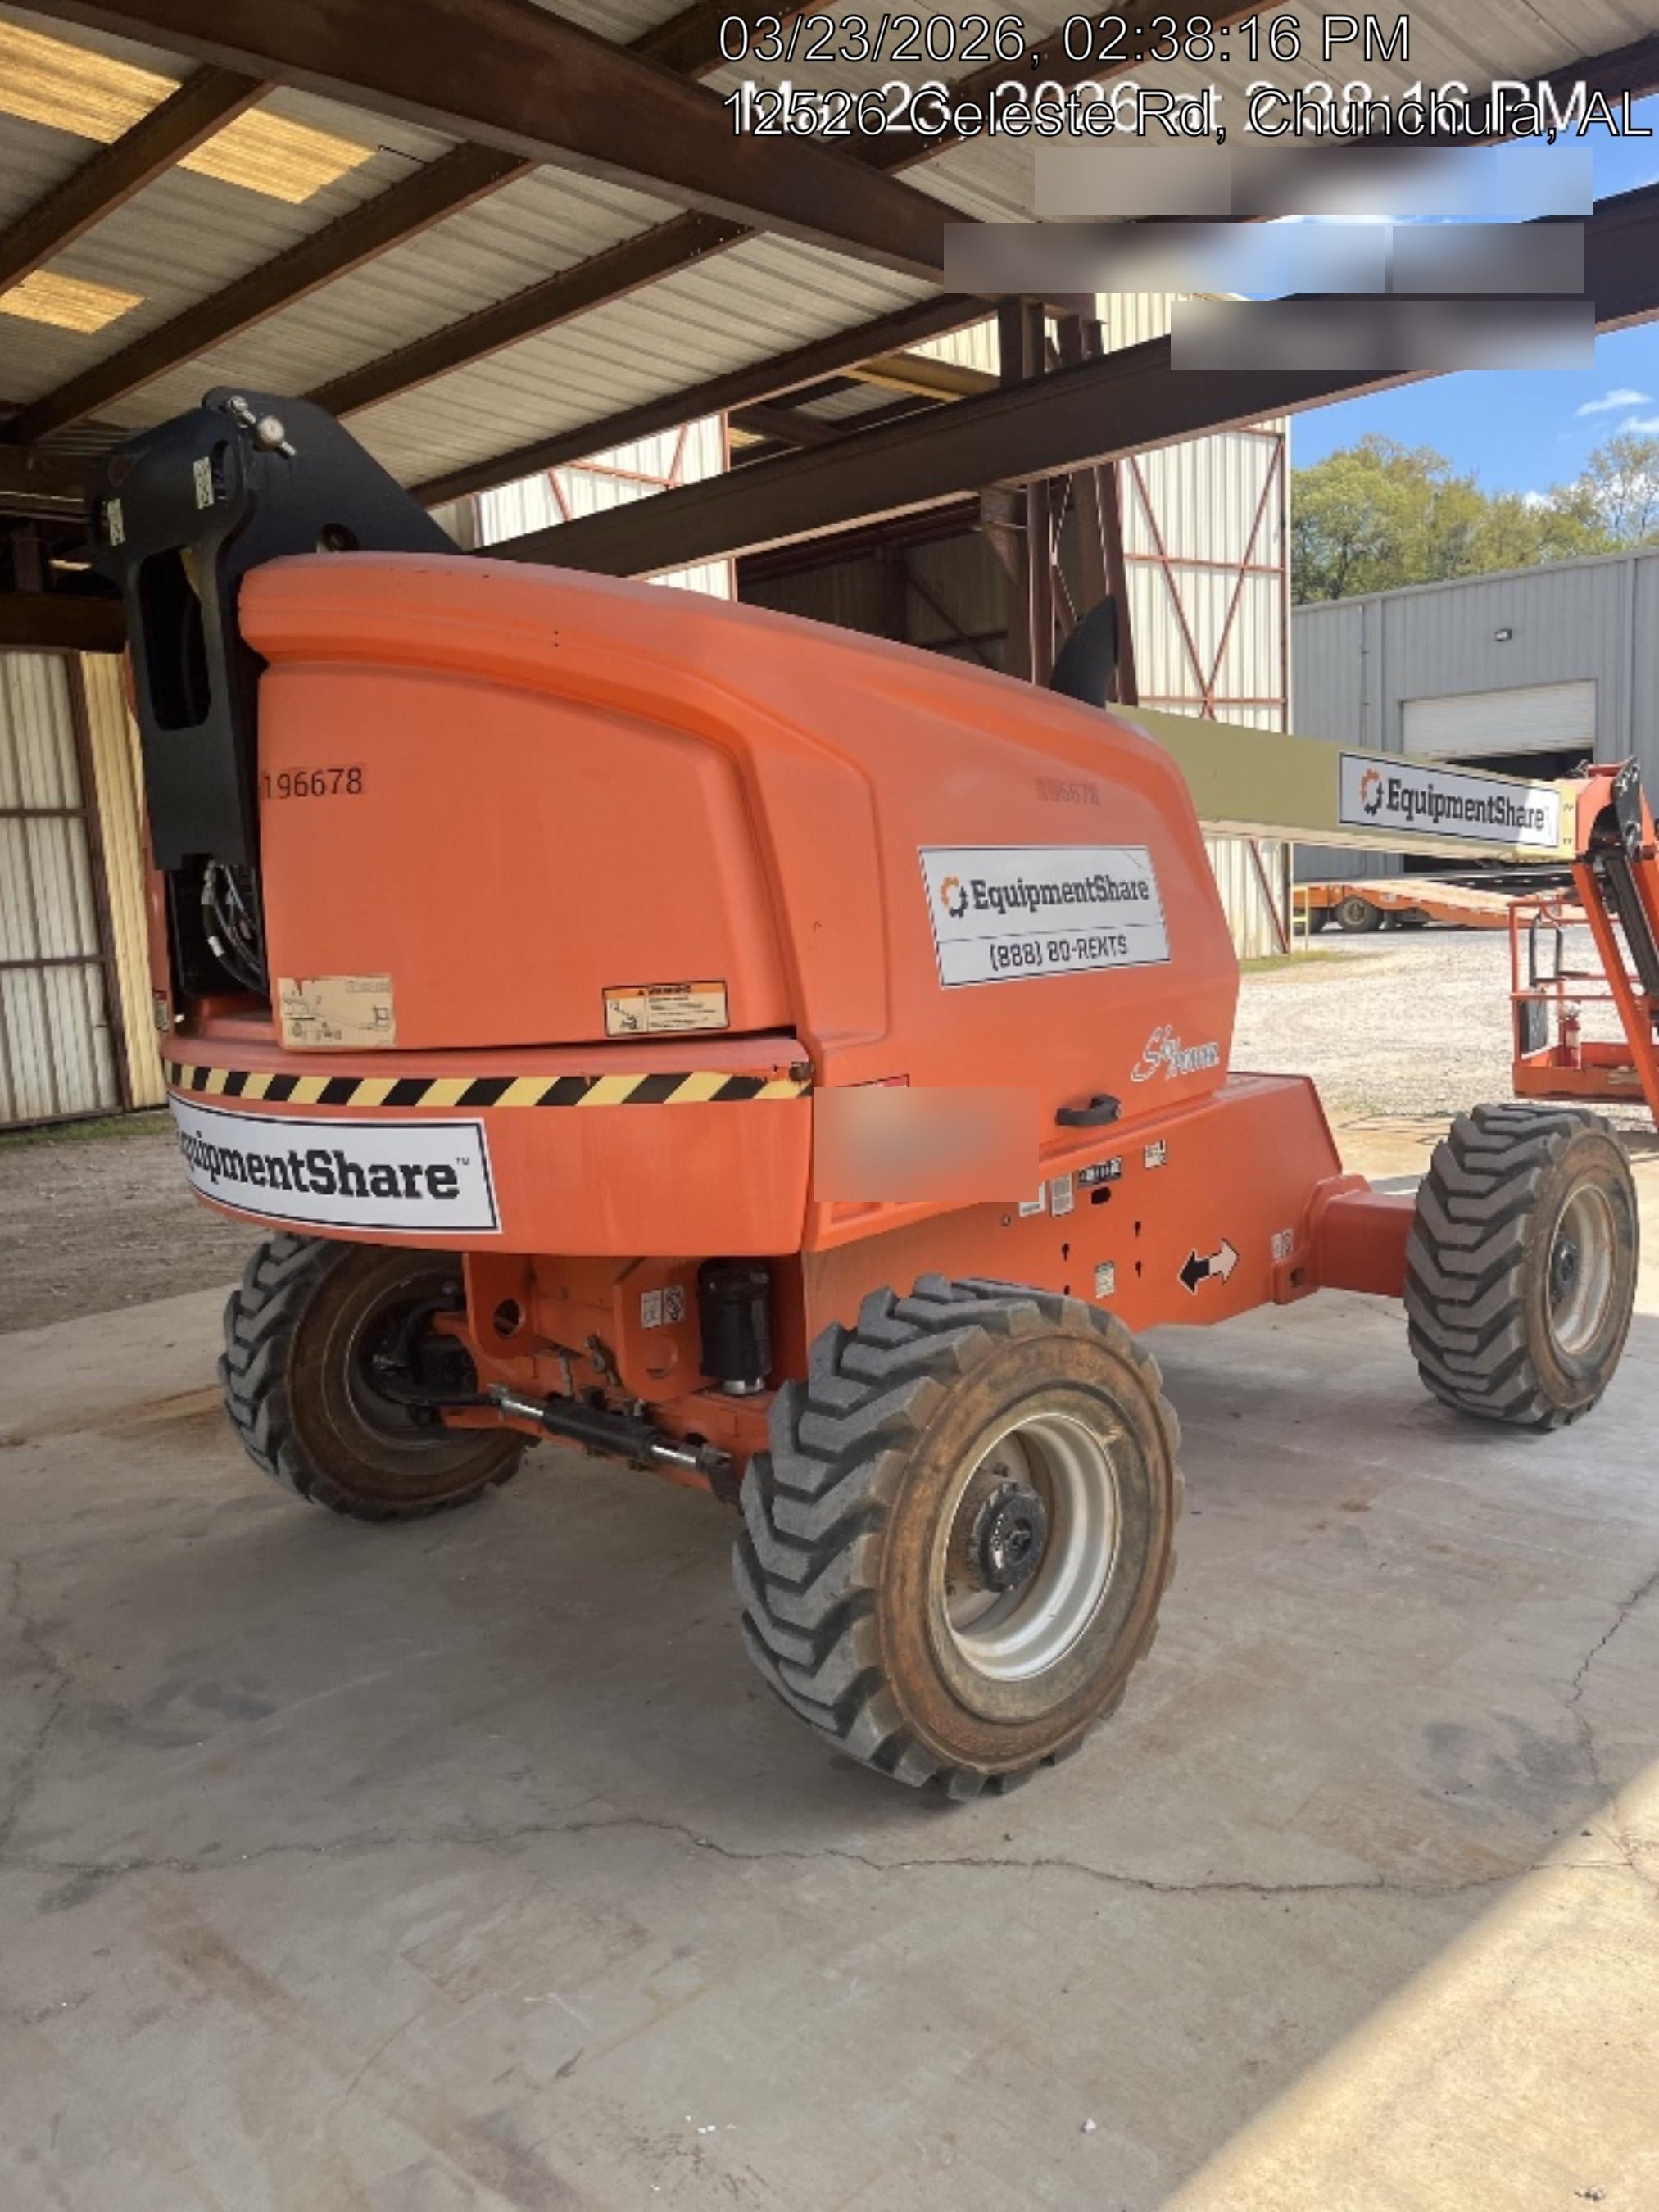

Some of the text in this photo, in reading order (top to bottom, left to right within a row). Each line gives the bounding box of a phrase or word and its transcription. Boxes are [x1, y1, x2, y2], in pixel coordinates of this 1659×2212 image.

[263, 766, 364, 800] 196678
[1385, 777, 1546, 831] EquipmentShare
[970, 873, 1151, 915] EquipmentShare
[990, 934, 1129, 972] (888) 80-RENTS
